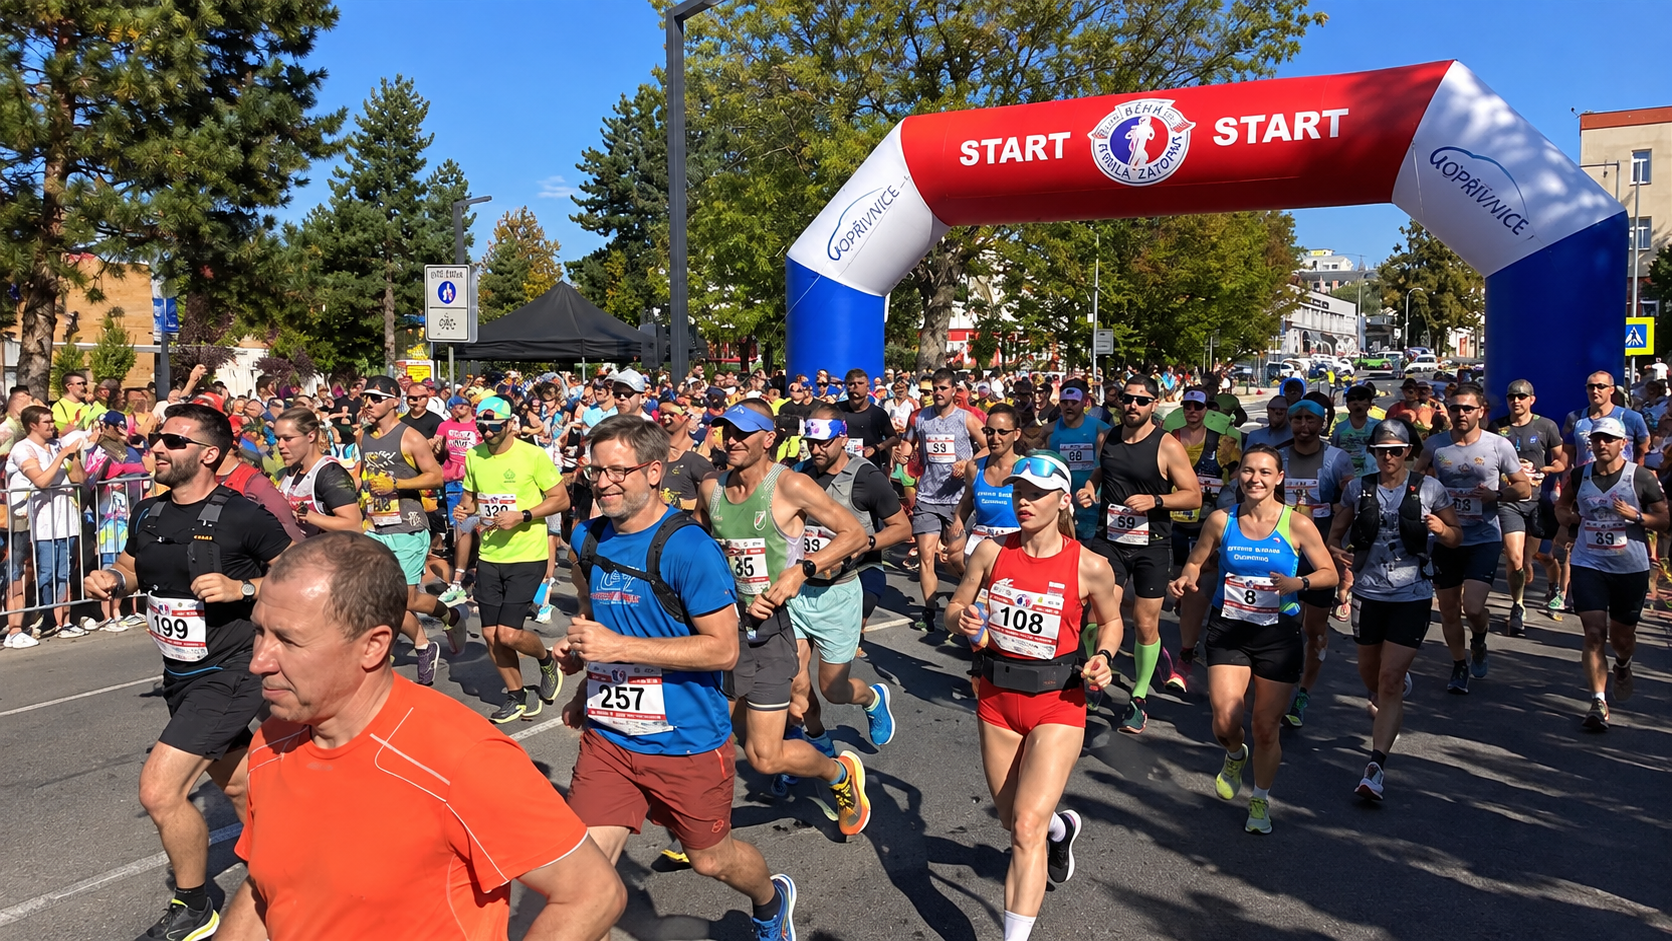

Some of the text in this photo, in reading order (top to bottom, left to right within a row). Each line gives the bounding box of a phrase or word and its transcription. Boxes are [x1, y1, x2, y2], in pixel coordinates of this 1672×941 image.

[1212, 108, 1349, 146] START
[959, 131, 1071, 166] START
[1244, 590, 1256, 605] 8
[154, 614, 189, 640] 199
[1000, 606, 1044, 635] 108
[599, 684, 645, 711] 257
